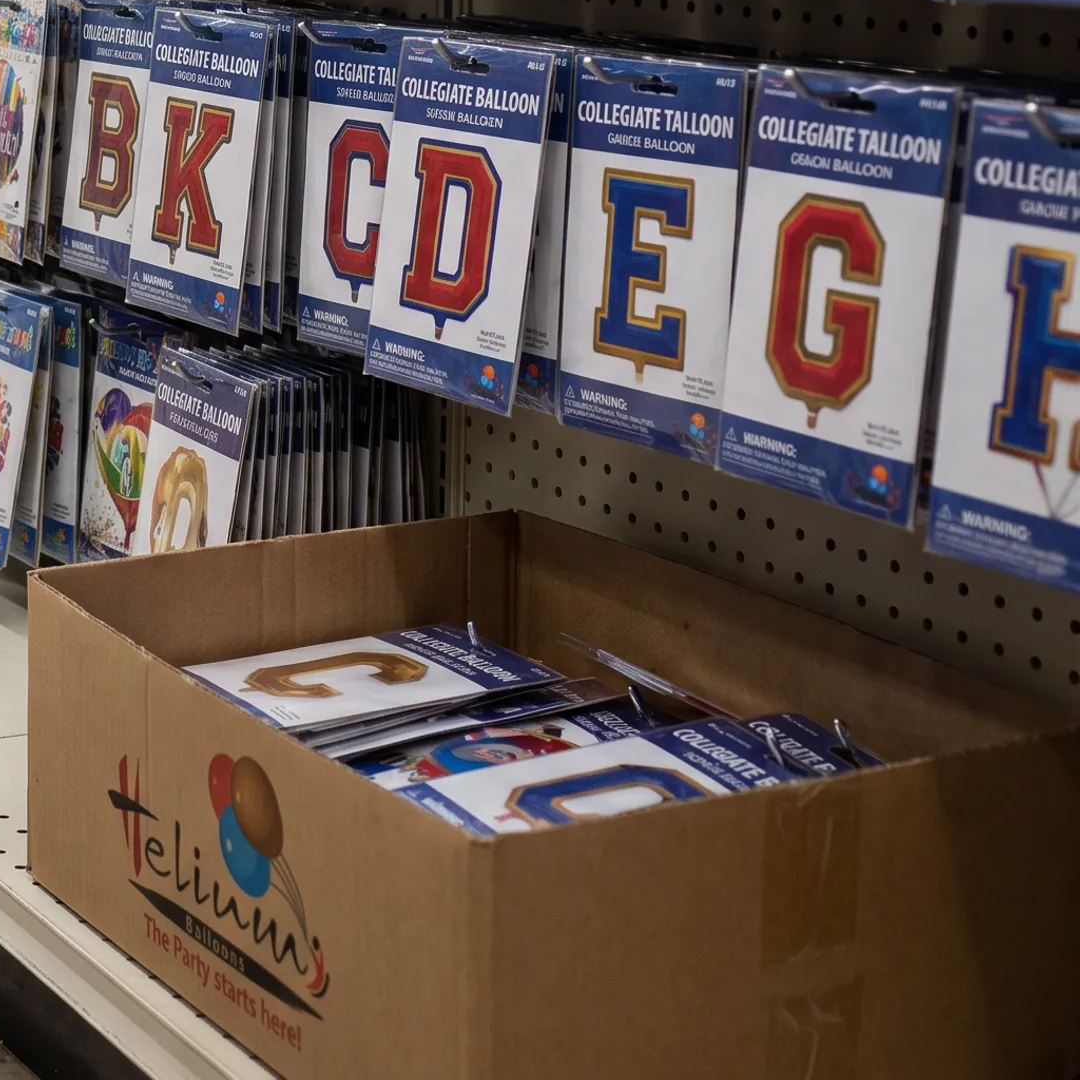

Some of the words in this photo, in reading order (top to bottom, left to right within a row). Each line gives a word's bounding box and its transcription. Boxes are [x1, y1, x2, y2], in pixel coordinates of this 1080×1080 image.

[156, 44, 210, 69] COLLEGIATE
[211, 54, 259, 78] BALLOON
[314, 60, 376, 85] COLLEGIATE
[402, 77, 473, 106] COLLEGIATE
[475, 86, 540, 116] BALLOON
[577, 100, 661, 130] COLLEGIATE
[664, 109, 734, 140] TALLOON
[79, 71, 140, 219] B
[644, 136, 695, 155] BALLOON
[758, 115, 855, 152] COLLEGIATE
[858, 127, 941, 165] TALLOON
[151, 96, 235, 260] K
[833, 157, 894, 180] BALLOON
[399, 137, 503, 323] D
[593, 166, 695, 372] E
[765, 192, 886, 413] G
[158, 382, 202, 417] COLLEGIATE
[202, 402, 242, 435] BALLOON
[580, 388, 628, 411] WARNING:
[185, 915, 246, 971] Balloons
[143, 912, 170, 954] The
[173, 934, 210, 989] Party
[214, 971, 257, 1018] starts
[260, 998, 302, 1051] here!
